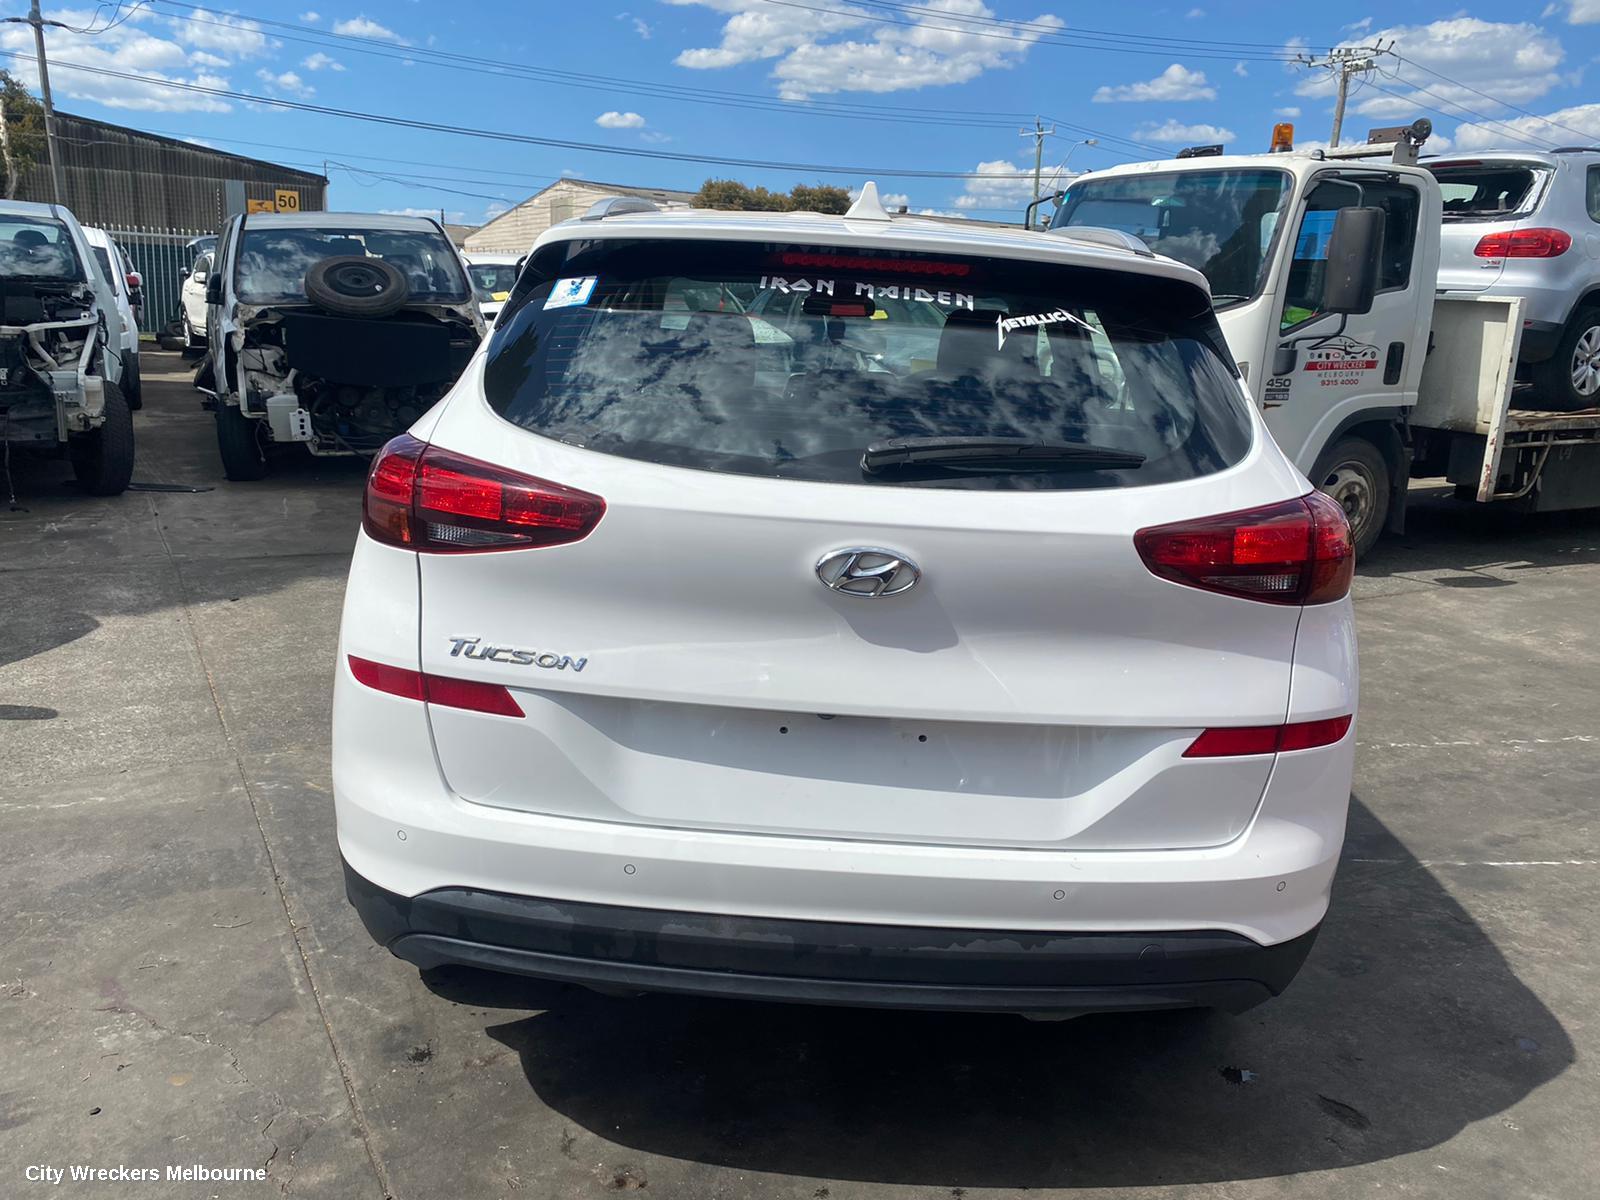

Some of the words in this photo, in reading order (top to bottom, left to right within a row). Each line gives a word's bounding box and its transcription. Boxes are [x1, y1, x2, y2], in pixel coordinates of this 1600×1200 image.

[278, 195, 297, 209] 50
[759, 275, 834, 296] IRON
[855, 281, 974, 312] MAIDEN
[996, 307, 1105, 351] METALLICA
[1316, 361, 1331, 370] CITY
[1333, 360, 1367, 369] WRECKERS
[1266, 378, 1292, 388] 450
[1340, 378, 1359, 386] 4000
[449, 637, 588, 673] TUCSON
